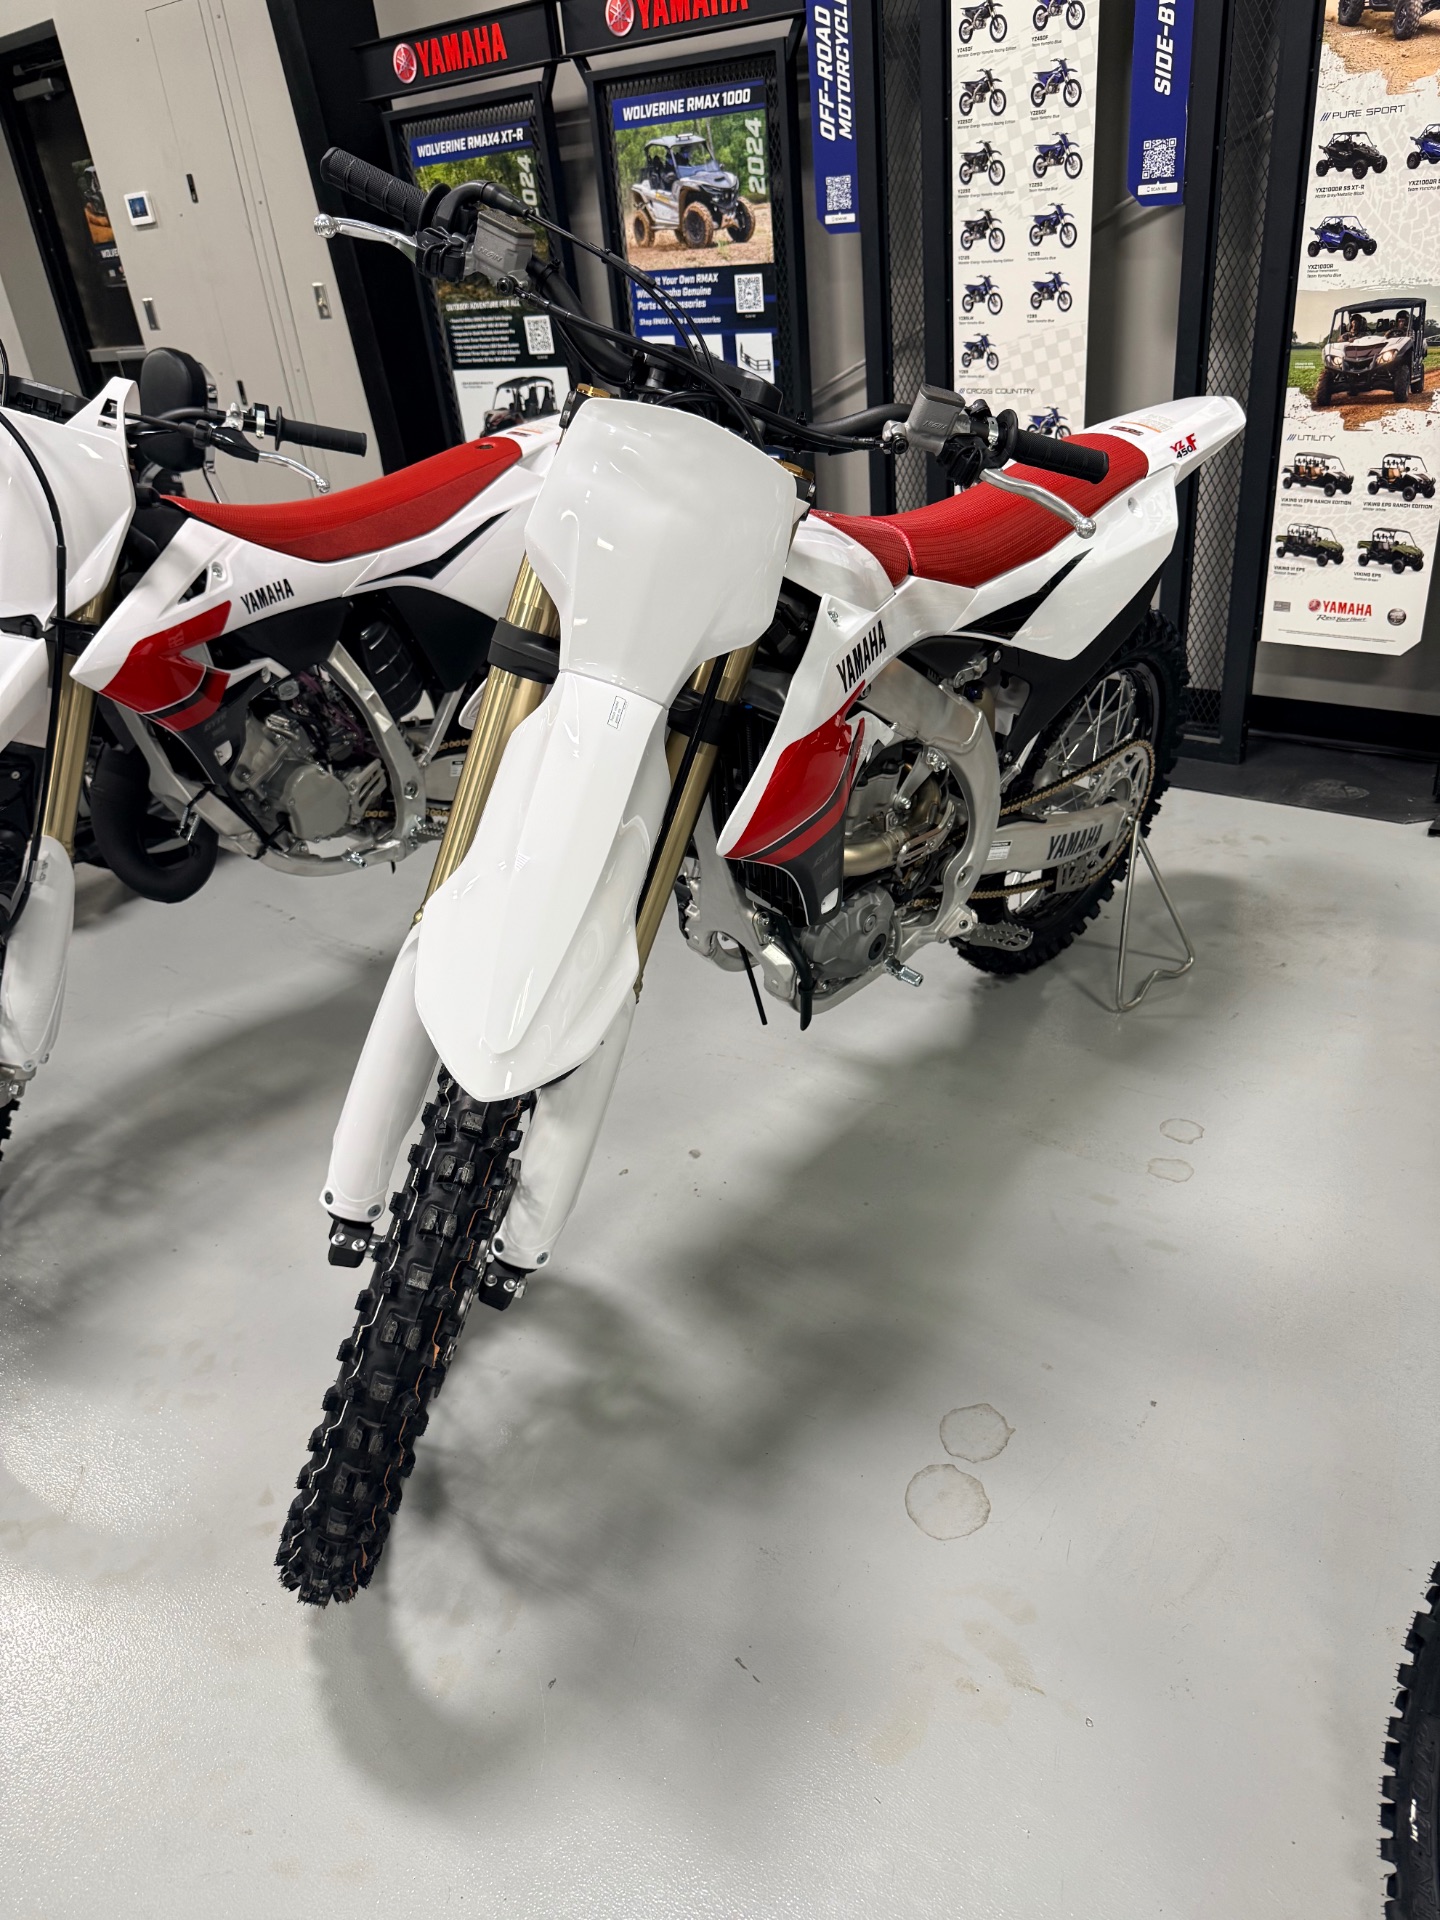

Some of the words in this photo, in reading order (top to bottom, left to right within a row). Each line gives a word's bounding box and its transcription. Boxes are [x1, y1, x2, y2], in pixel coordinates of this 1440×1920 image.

[414, 23, 508, 77] YAMAHA
[814, 5, 836, 141] OFF-ROAD
[622, 99, 684, 121] WOLVERINE
[687, 93, 721, 111] RMAX
[722, 88, 751, 106] 1000
[1332, 109, 1362, 119] PURE
[1366, 104, 1406, 116] SPORT
[417, 138, 466, 158] WOLVERINE
[467, 132, 500, 149] RMAX4
[501, 127, 523, 143] XT-R
[744, 117, 766, 195] 2024
[517, 154, 540, 216] 024
[662, 276, 678, 286] Your
[679, 274, 695, 285] Own
[696, 273, 719, 284] RMAX
[682, 286, 712, 297] Genuine
[637, 301, 656, 310] Parts
[966, 387, 993, 395] CROSS
[994, 387, 1035, 395] COUNTRY
[1176, 444, 1194, 459] 450
[1297, 434, 1336, 442] UTILITY
[240, 578, 295, 615] YAMAHA
[1323, 600, 1372, 617] YAMAHA
[836, 619, 887, 694] YAMAHA
[1046, 824, 1104, 861] YAMAHA
